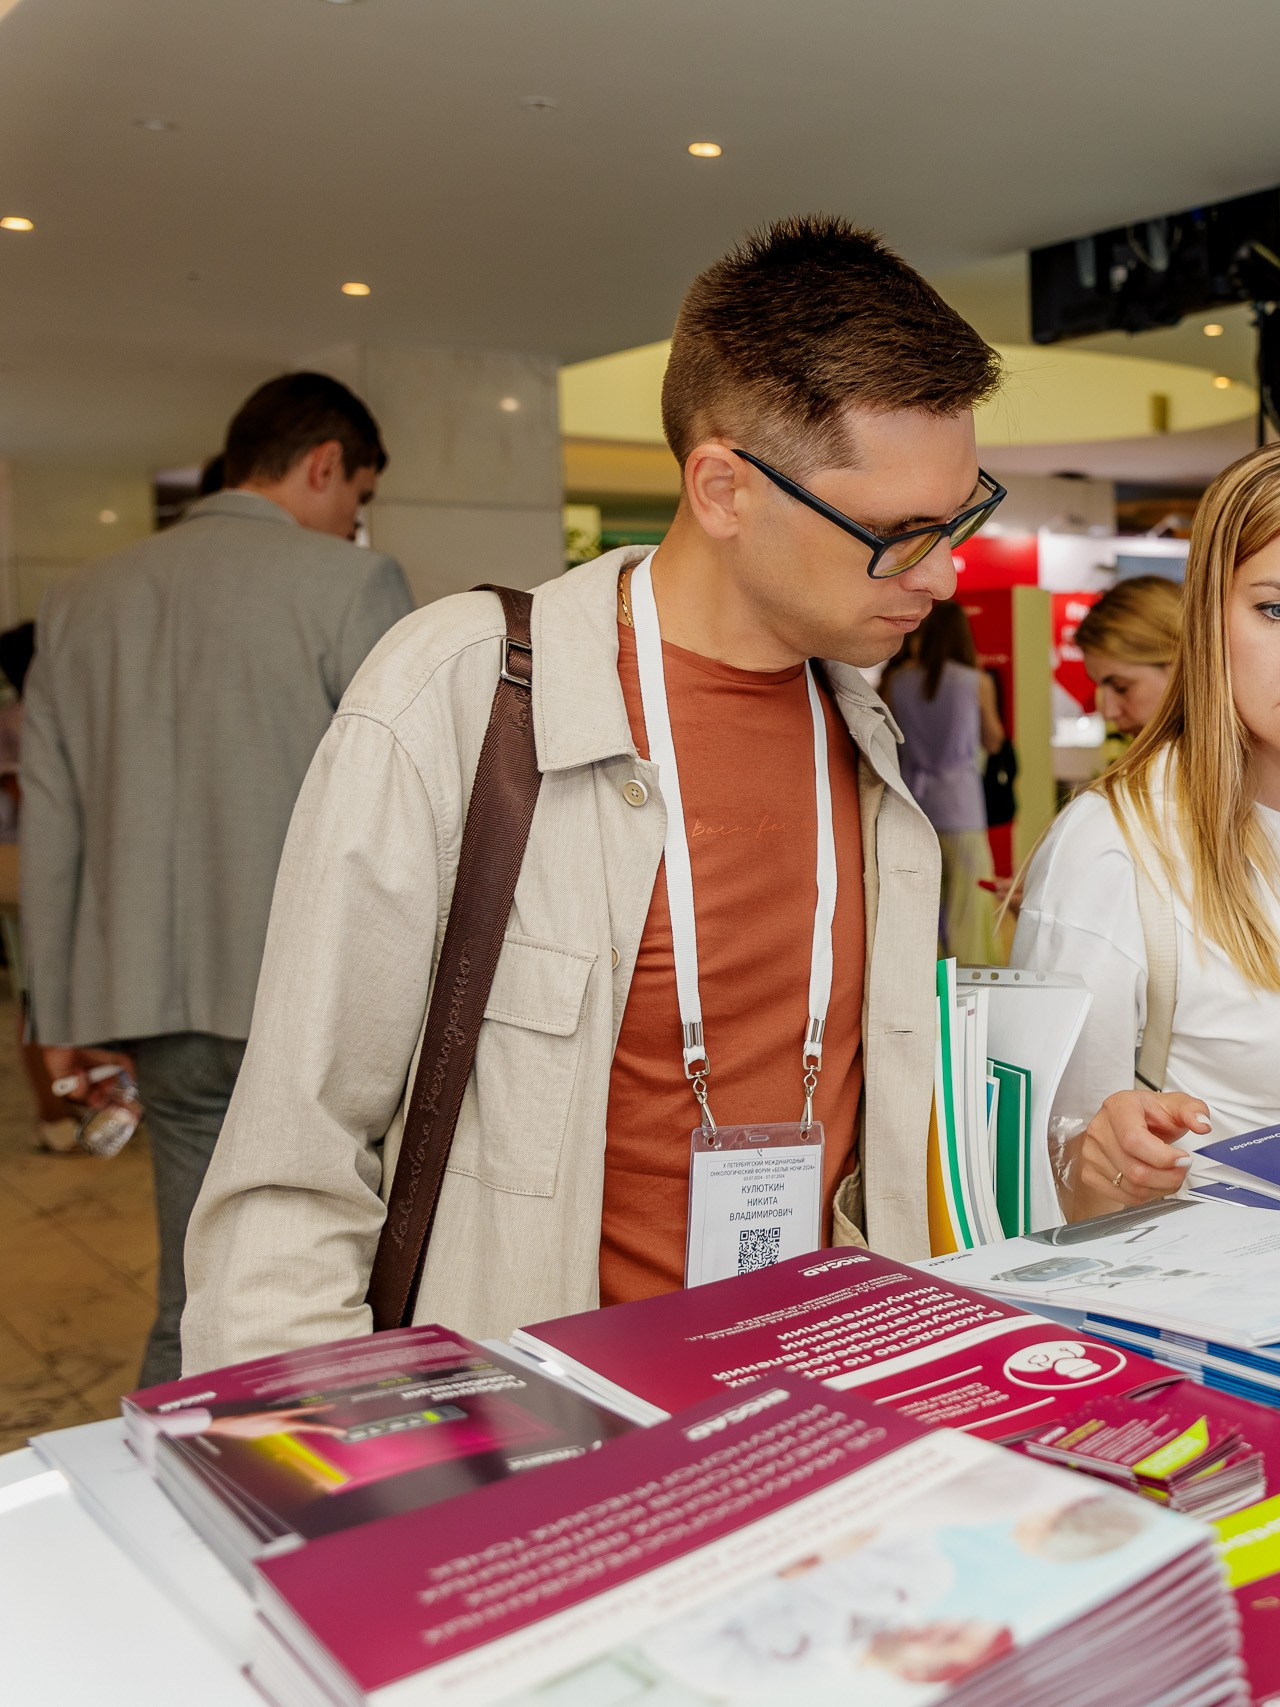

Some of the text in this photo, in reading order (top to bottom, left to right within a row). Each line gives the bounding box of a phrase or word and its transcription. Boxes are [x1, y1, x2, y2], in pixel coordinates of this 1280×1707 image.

[741, 1183, 785, 1193] КУЛЮТКИН
[747, 1197, 778, 1206] НИКИТА
[729, 1208, 793, 1221] ВЛАДИМИРОВИЧ
[775, 1280, 940, 1344] иммунотерапии
[778, 1285, 955, 1355] при применении
[711, 1294, 970, 1382] нежелательных явлений
[873, 1304, 1005, 1359] Руководство
[841, 1350, 868, 1369] по
